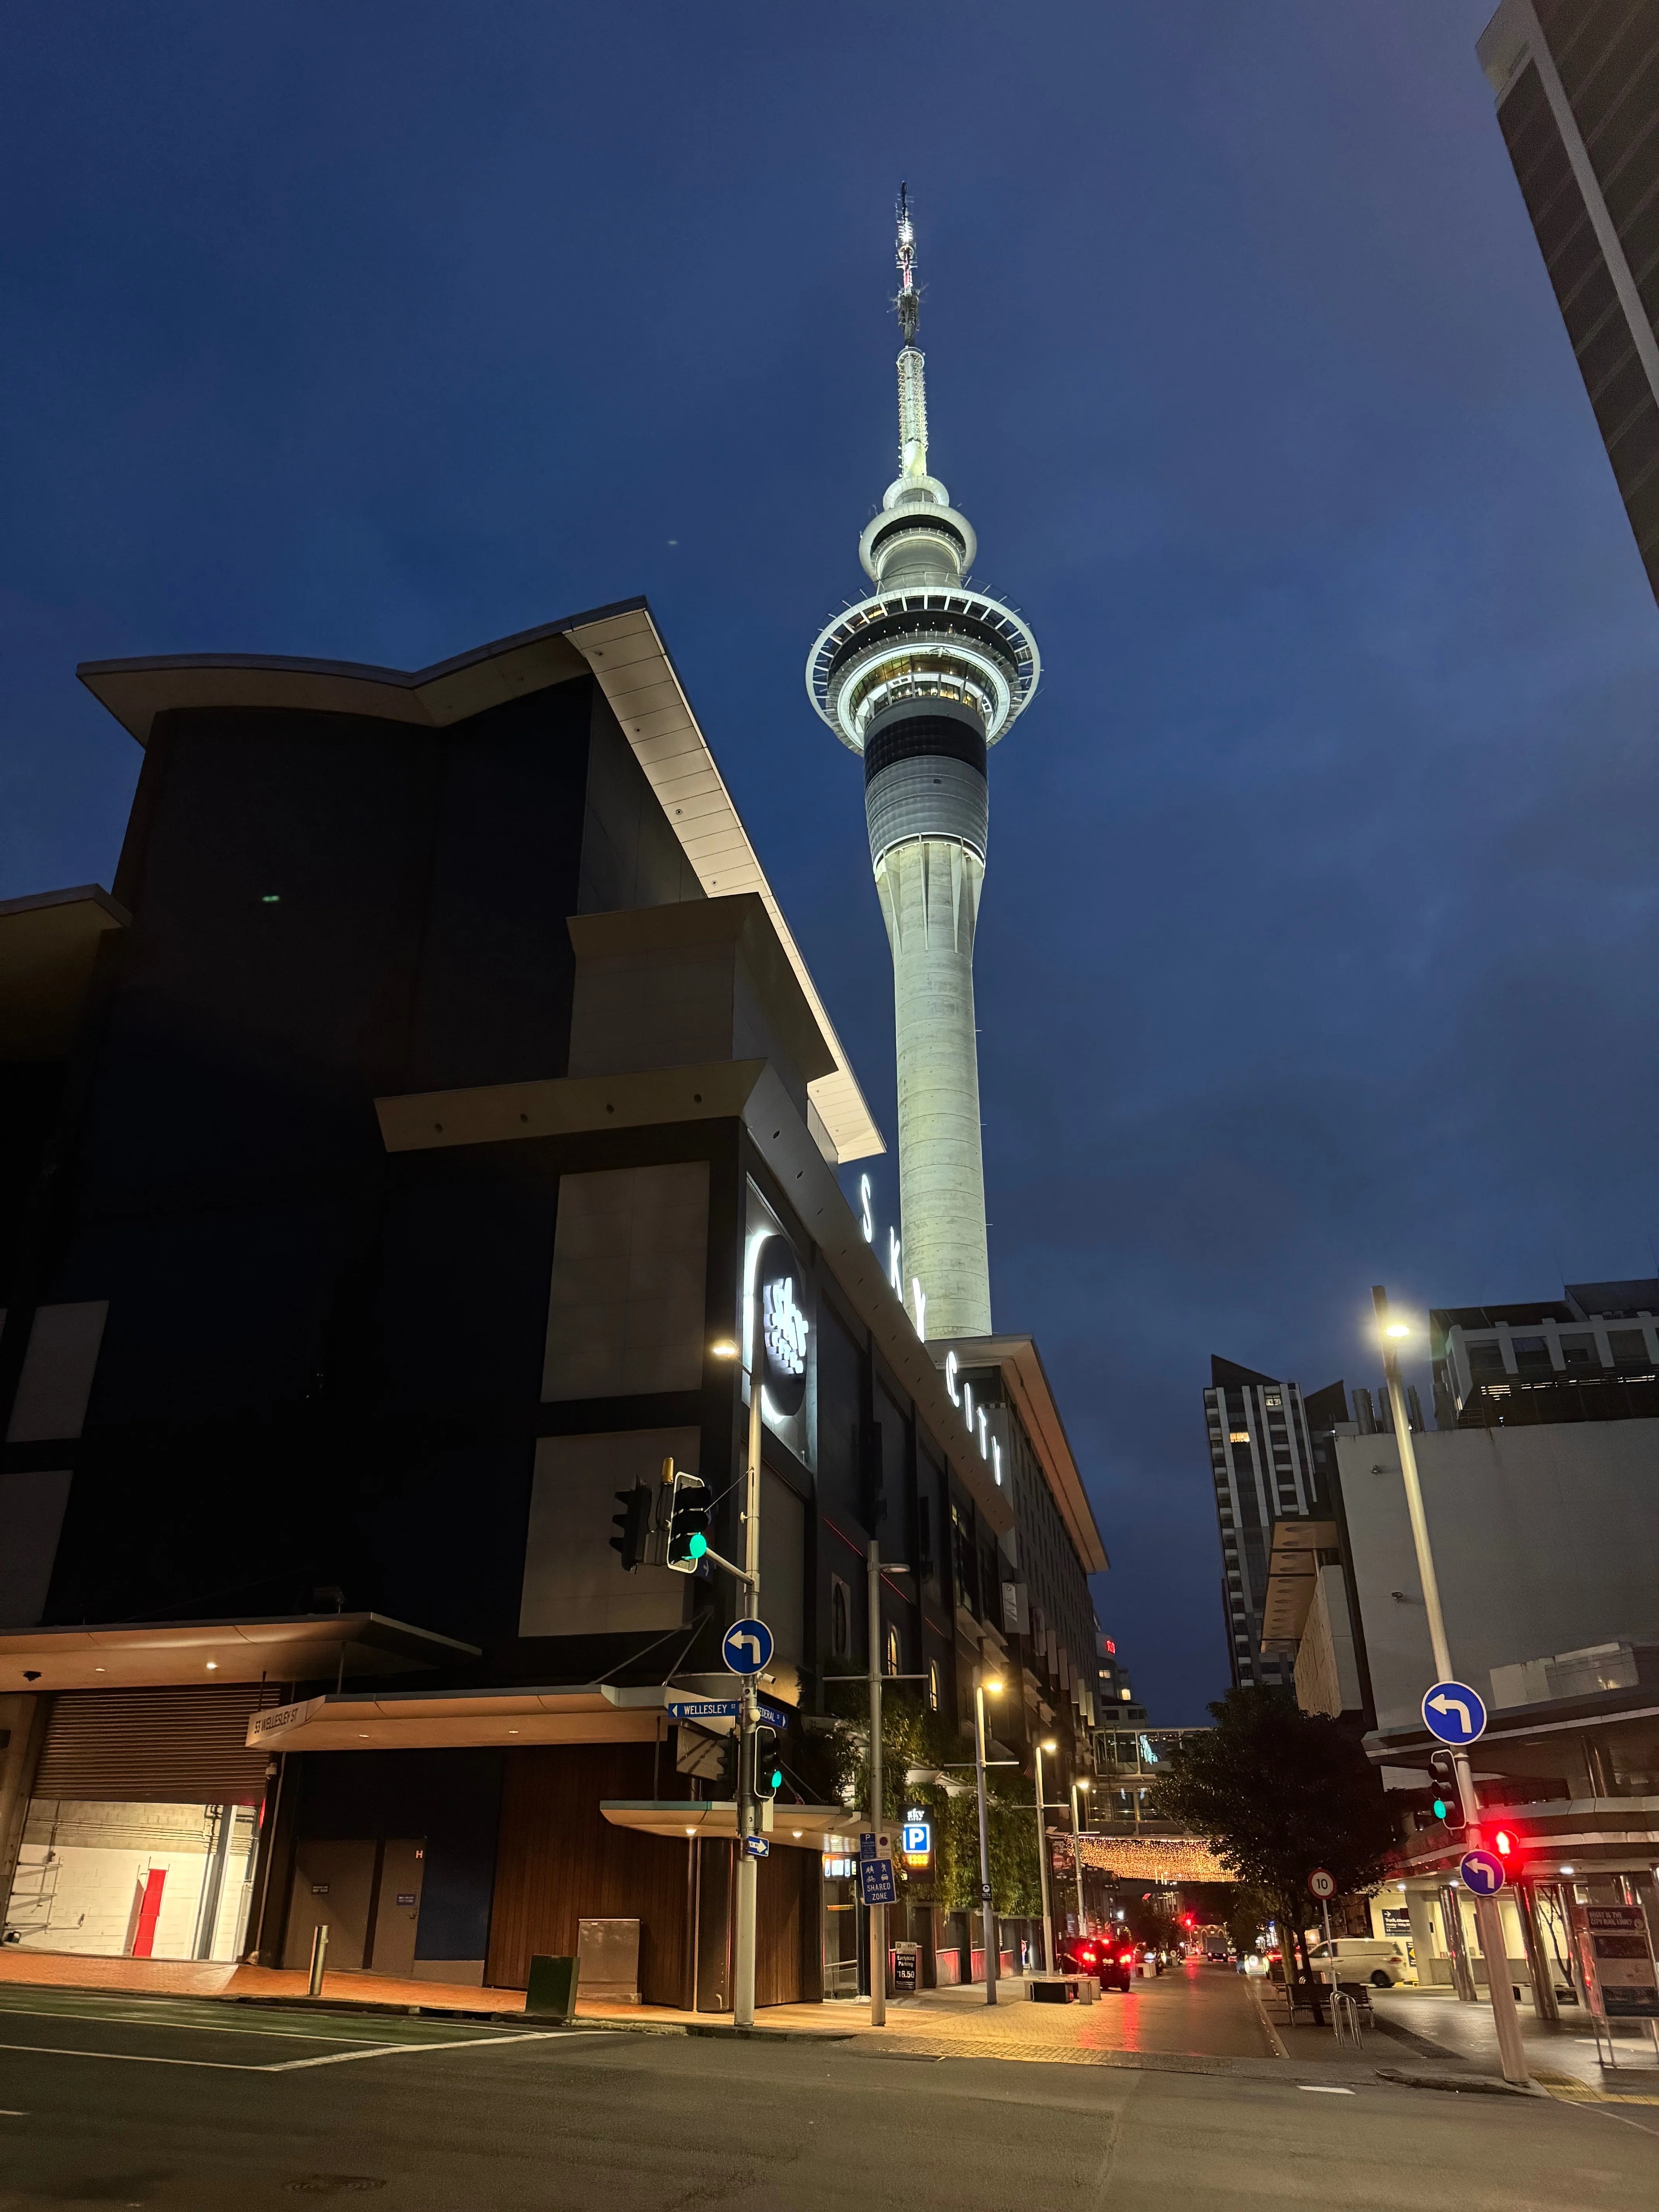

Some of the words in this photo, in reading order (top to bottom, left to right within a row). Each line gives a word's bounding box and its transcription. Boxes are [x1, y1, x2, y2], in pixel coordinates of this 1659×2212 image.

[684, 1704, 727, 1715] WELLESLEY
[261, 1710, 291, 1731] WELLESLEY
[290, 1707, 299, 1723] ST
[909, 1828, 924, 1849] P
[416, 1850, 423, 1858] H
[867, 1882, 891, 1892] SHARED
[1316, 1878, 1328, 1890] 10
[872, 1893, 888, 1901] ZONE
